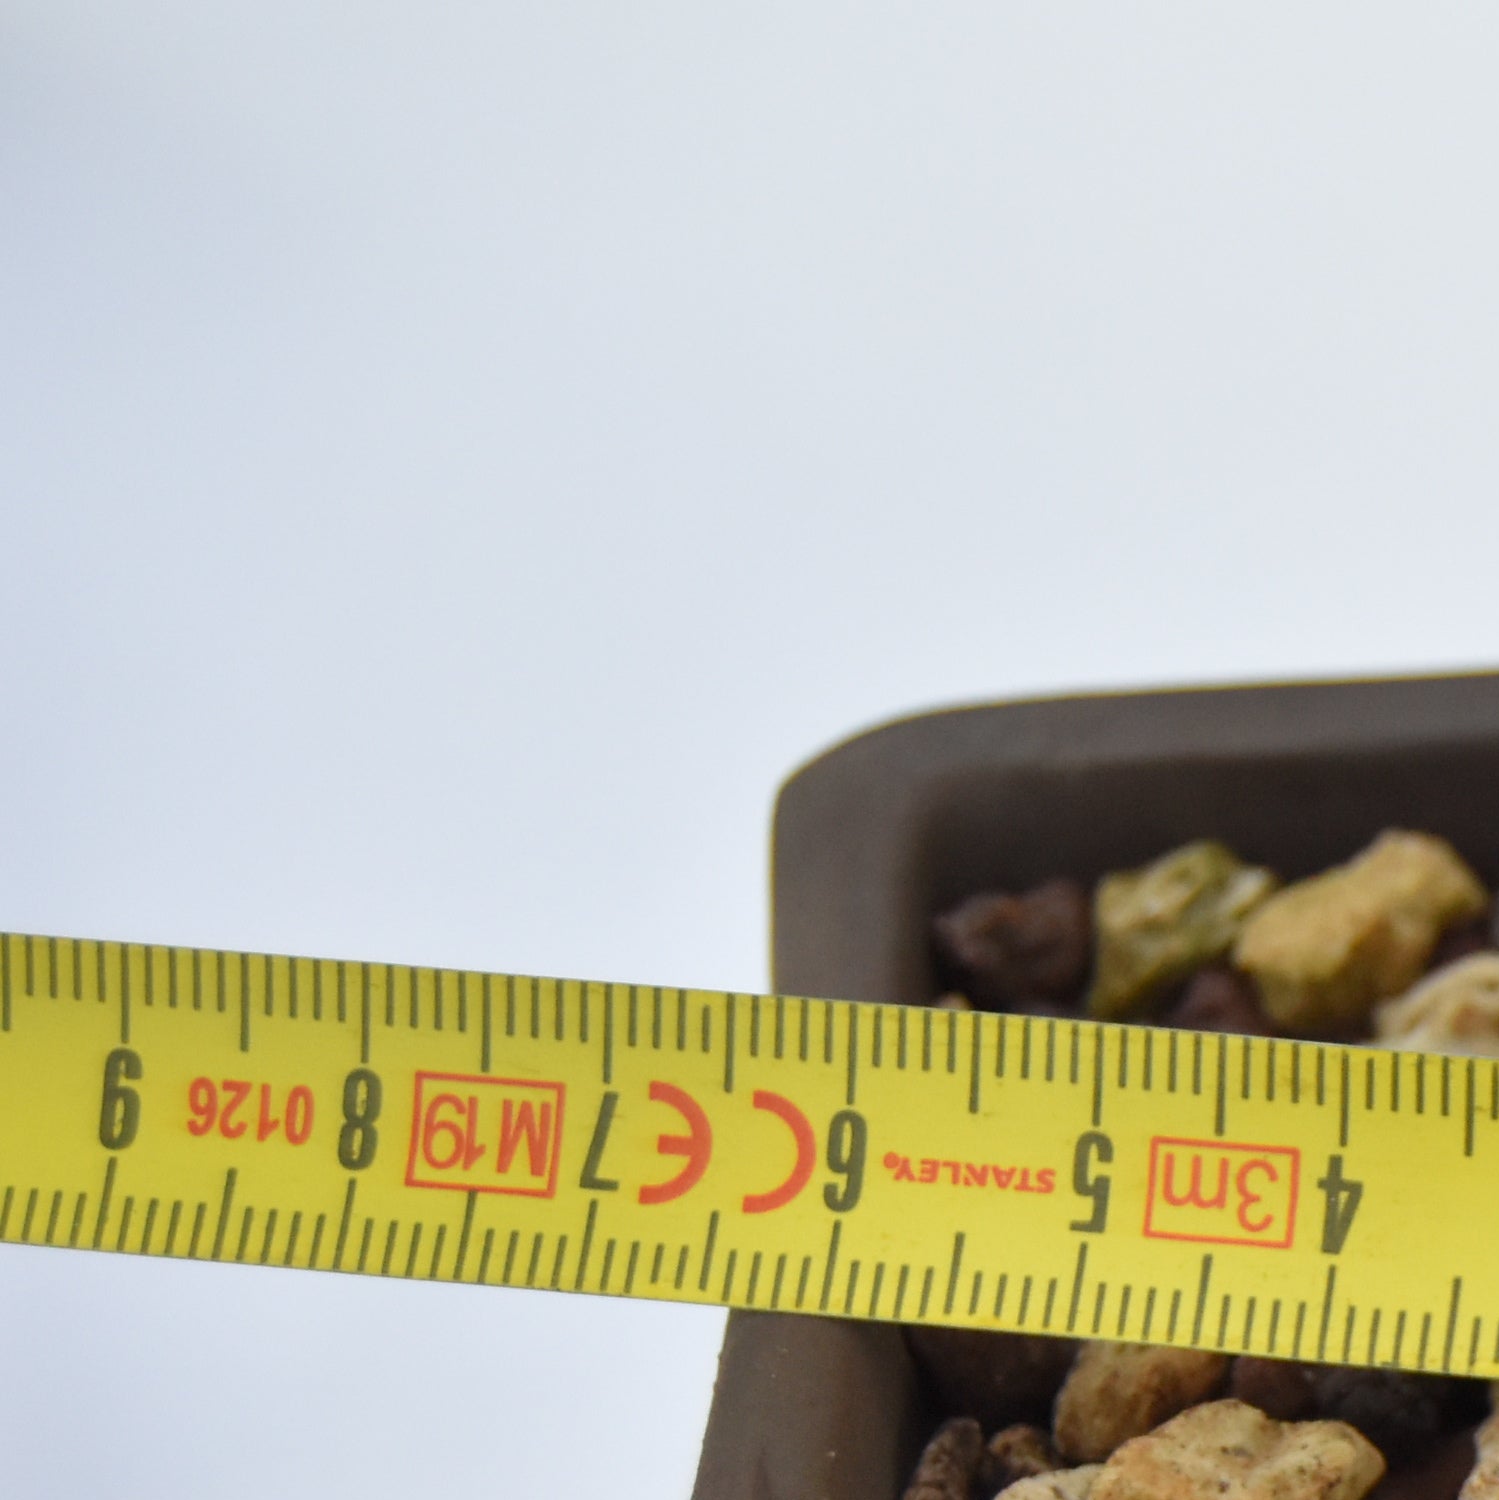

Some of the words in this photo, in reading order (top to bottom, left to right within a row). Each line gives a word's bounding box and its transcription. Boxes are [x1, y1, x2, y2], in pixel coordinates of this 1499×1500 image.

[100, 1048, 142, 1150] 9
[188, 1077, 314, 1145] 0126
[337, 1068, 382, 1170] 8
[422, 1093, 552, 1176] M19
[579, 1092, 619, 1191] 7
[823, 1109, 868, 1213] 6
[1069, 1131, 1114, 1232] 5
[1162, 1154, 1278, 1232] 3m
[1317, 1155, 1363, 1254] 4
